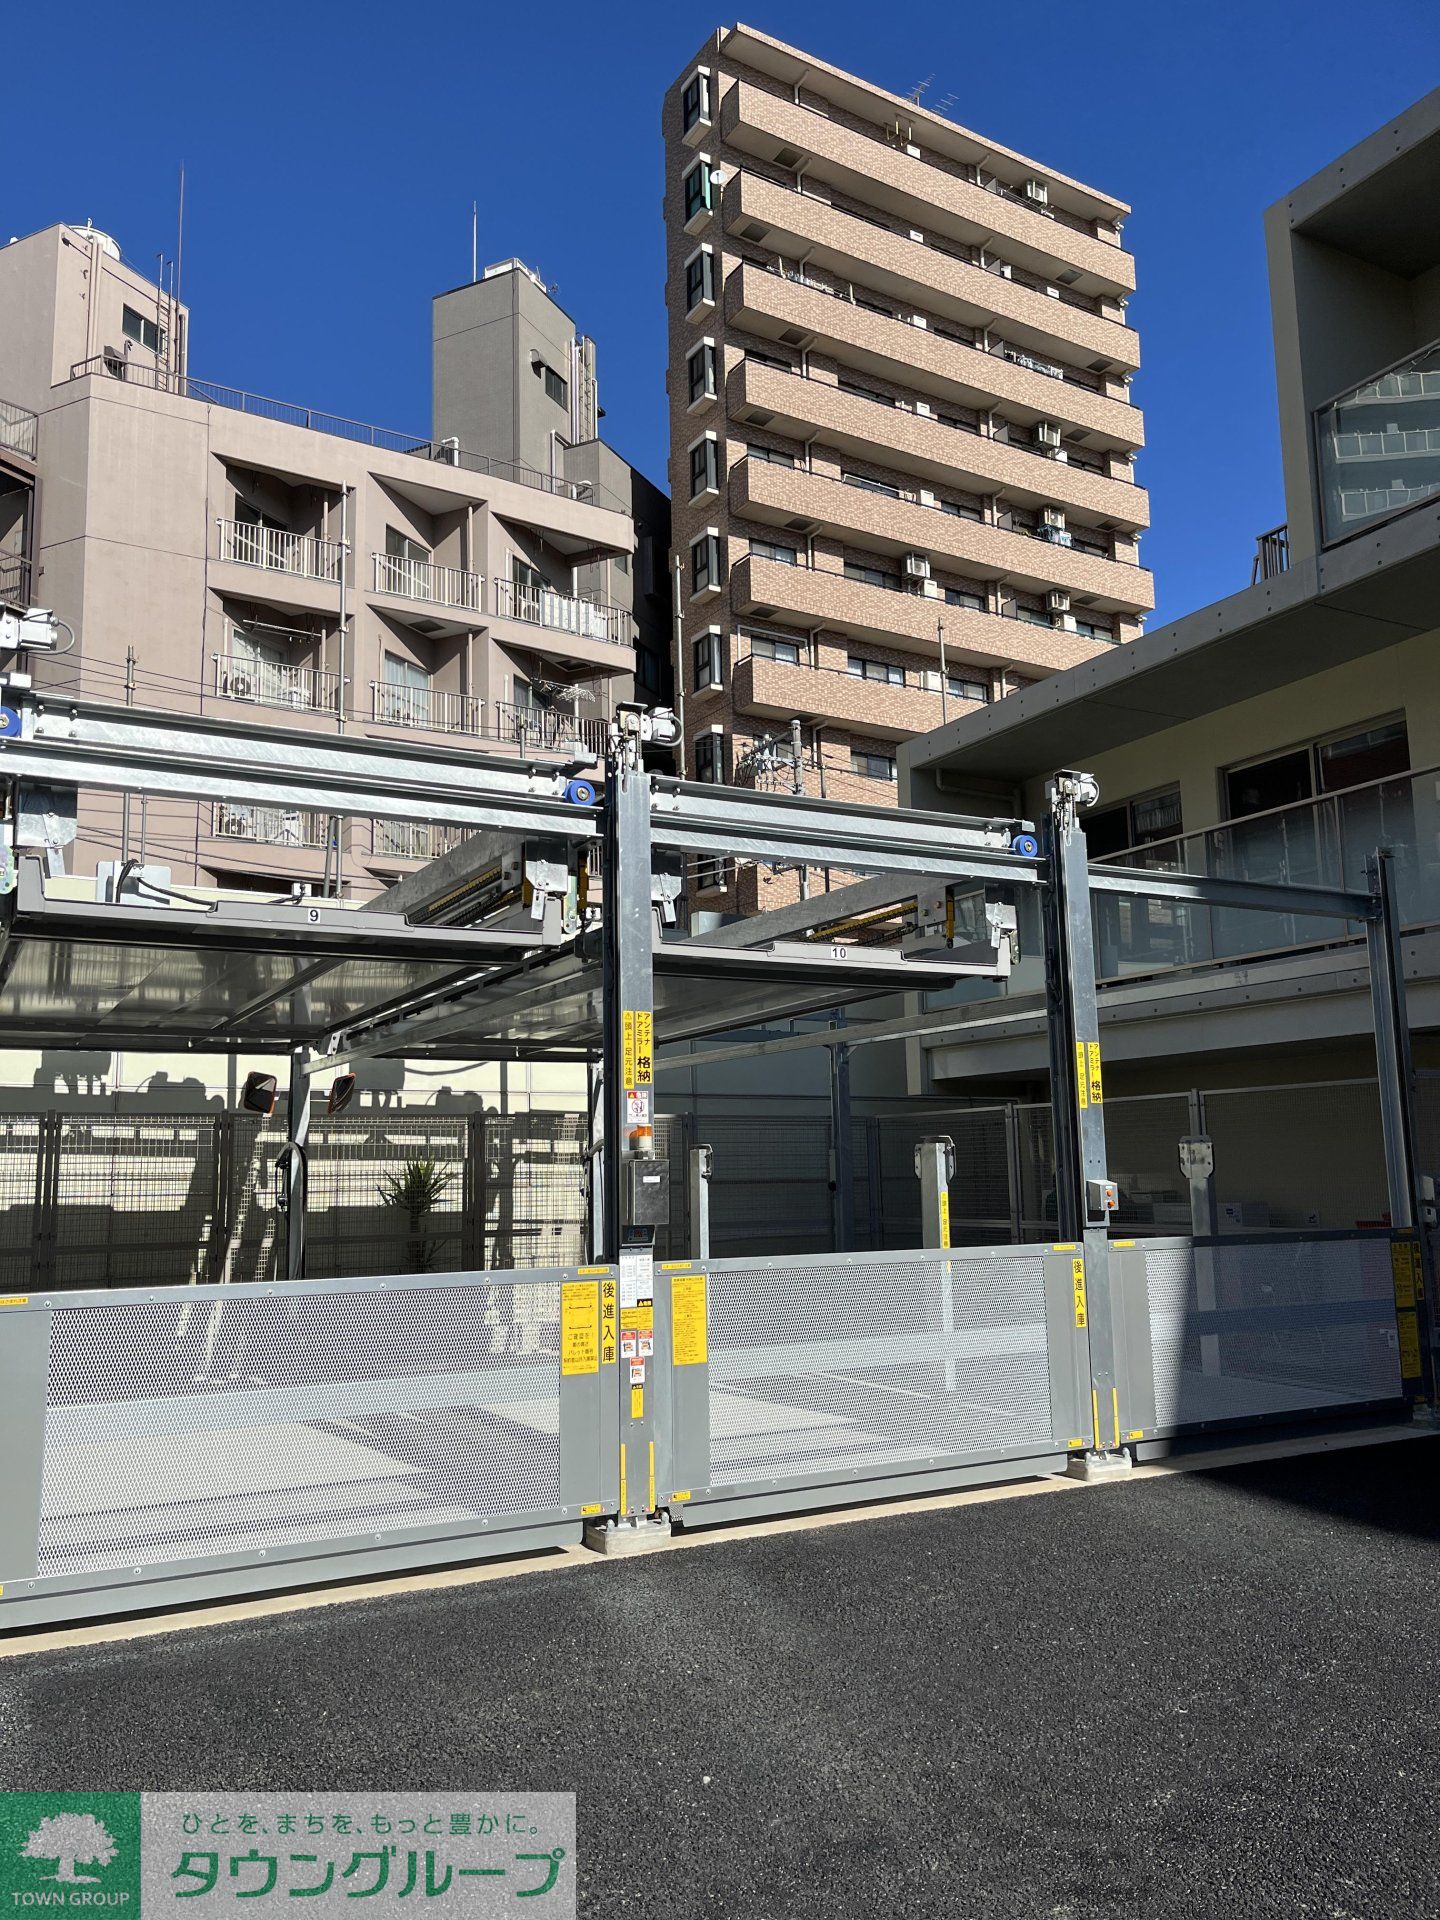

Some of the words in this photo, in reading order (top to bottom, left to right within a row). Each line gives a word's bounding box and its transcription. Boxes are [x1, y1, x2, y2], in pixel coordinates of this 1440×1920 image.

[309, 909, 319, 922] 9
[832, 947, 847, 959] 10
[643, 1012, 651, 1046] アンテナ
[637, 1055, 651, 1083] 格納
[1091, 1080, 1102, 1103] 格納
[1073, 1260, 1085, 1327] 後進入庫
[602, 1282, 615, 1362] 後進入庫
